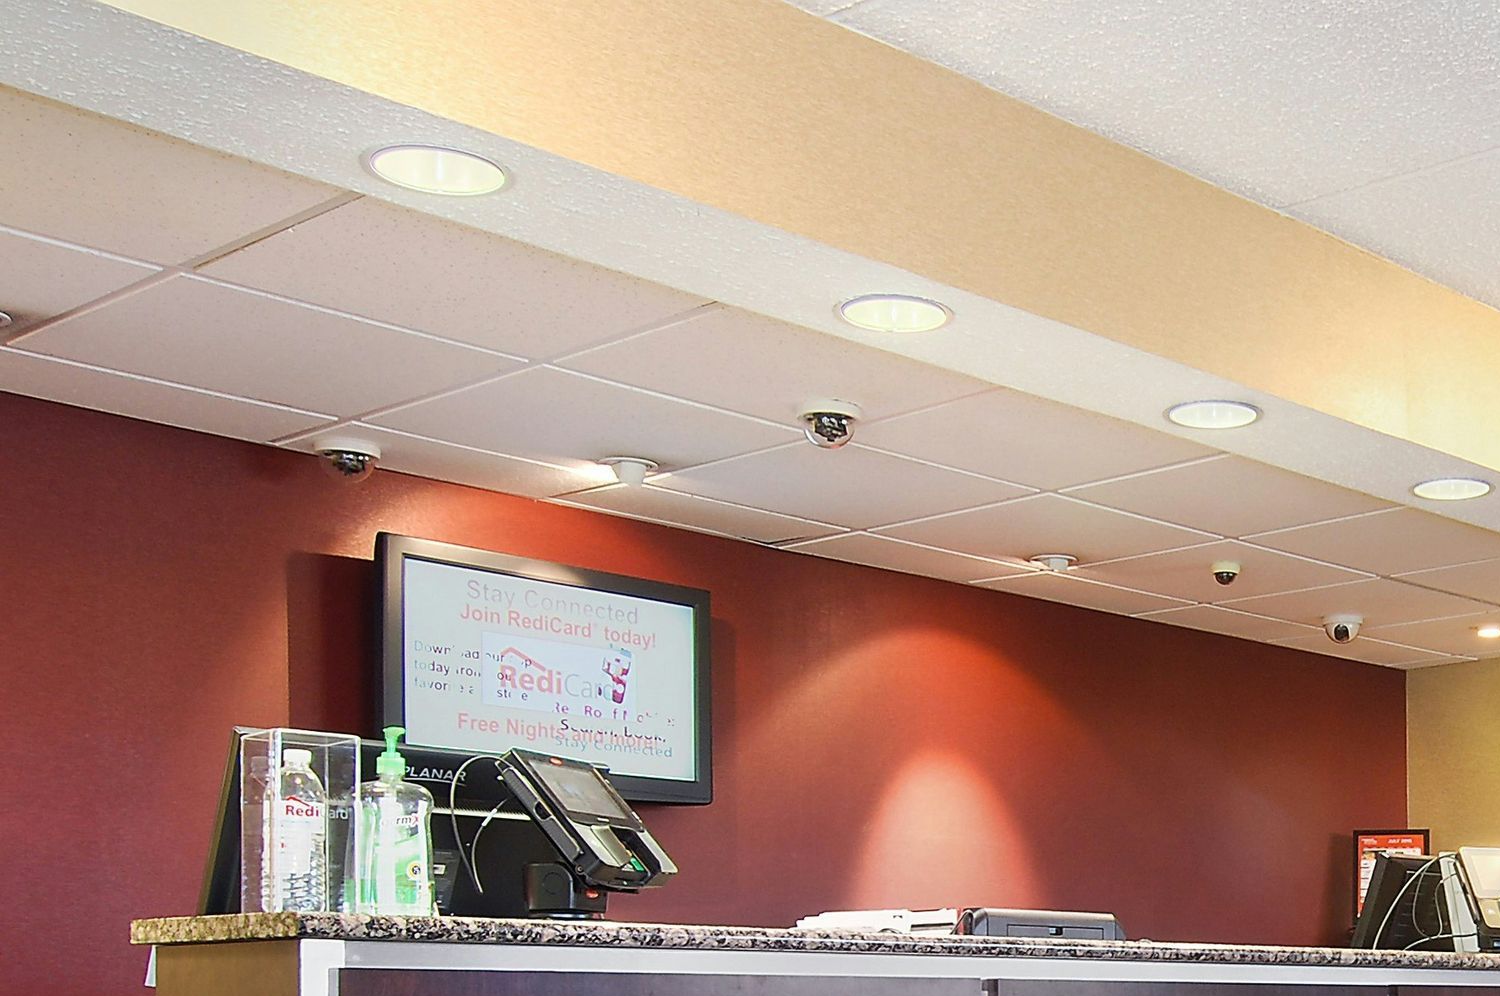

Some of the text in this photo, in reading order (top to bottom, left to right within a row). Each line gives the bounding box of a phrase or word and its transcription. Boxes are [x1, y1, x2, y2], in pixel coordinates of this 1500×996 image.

[466, 579, 639, 624] Stay Connected
[460, 604, 501, 624] Join
[604, 625, 656, 650] today!
[414, 640, 480, 660] Downad
[457, 712, 500, 733] Free
[506, 718, 564, 741] Nights
[555, 735, 674, 758] Stay Connected
